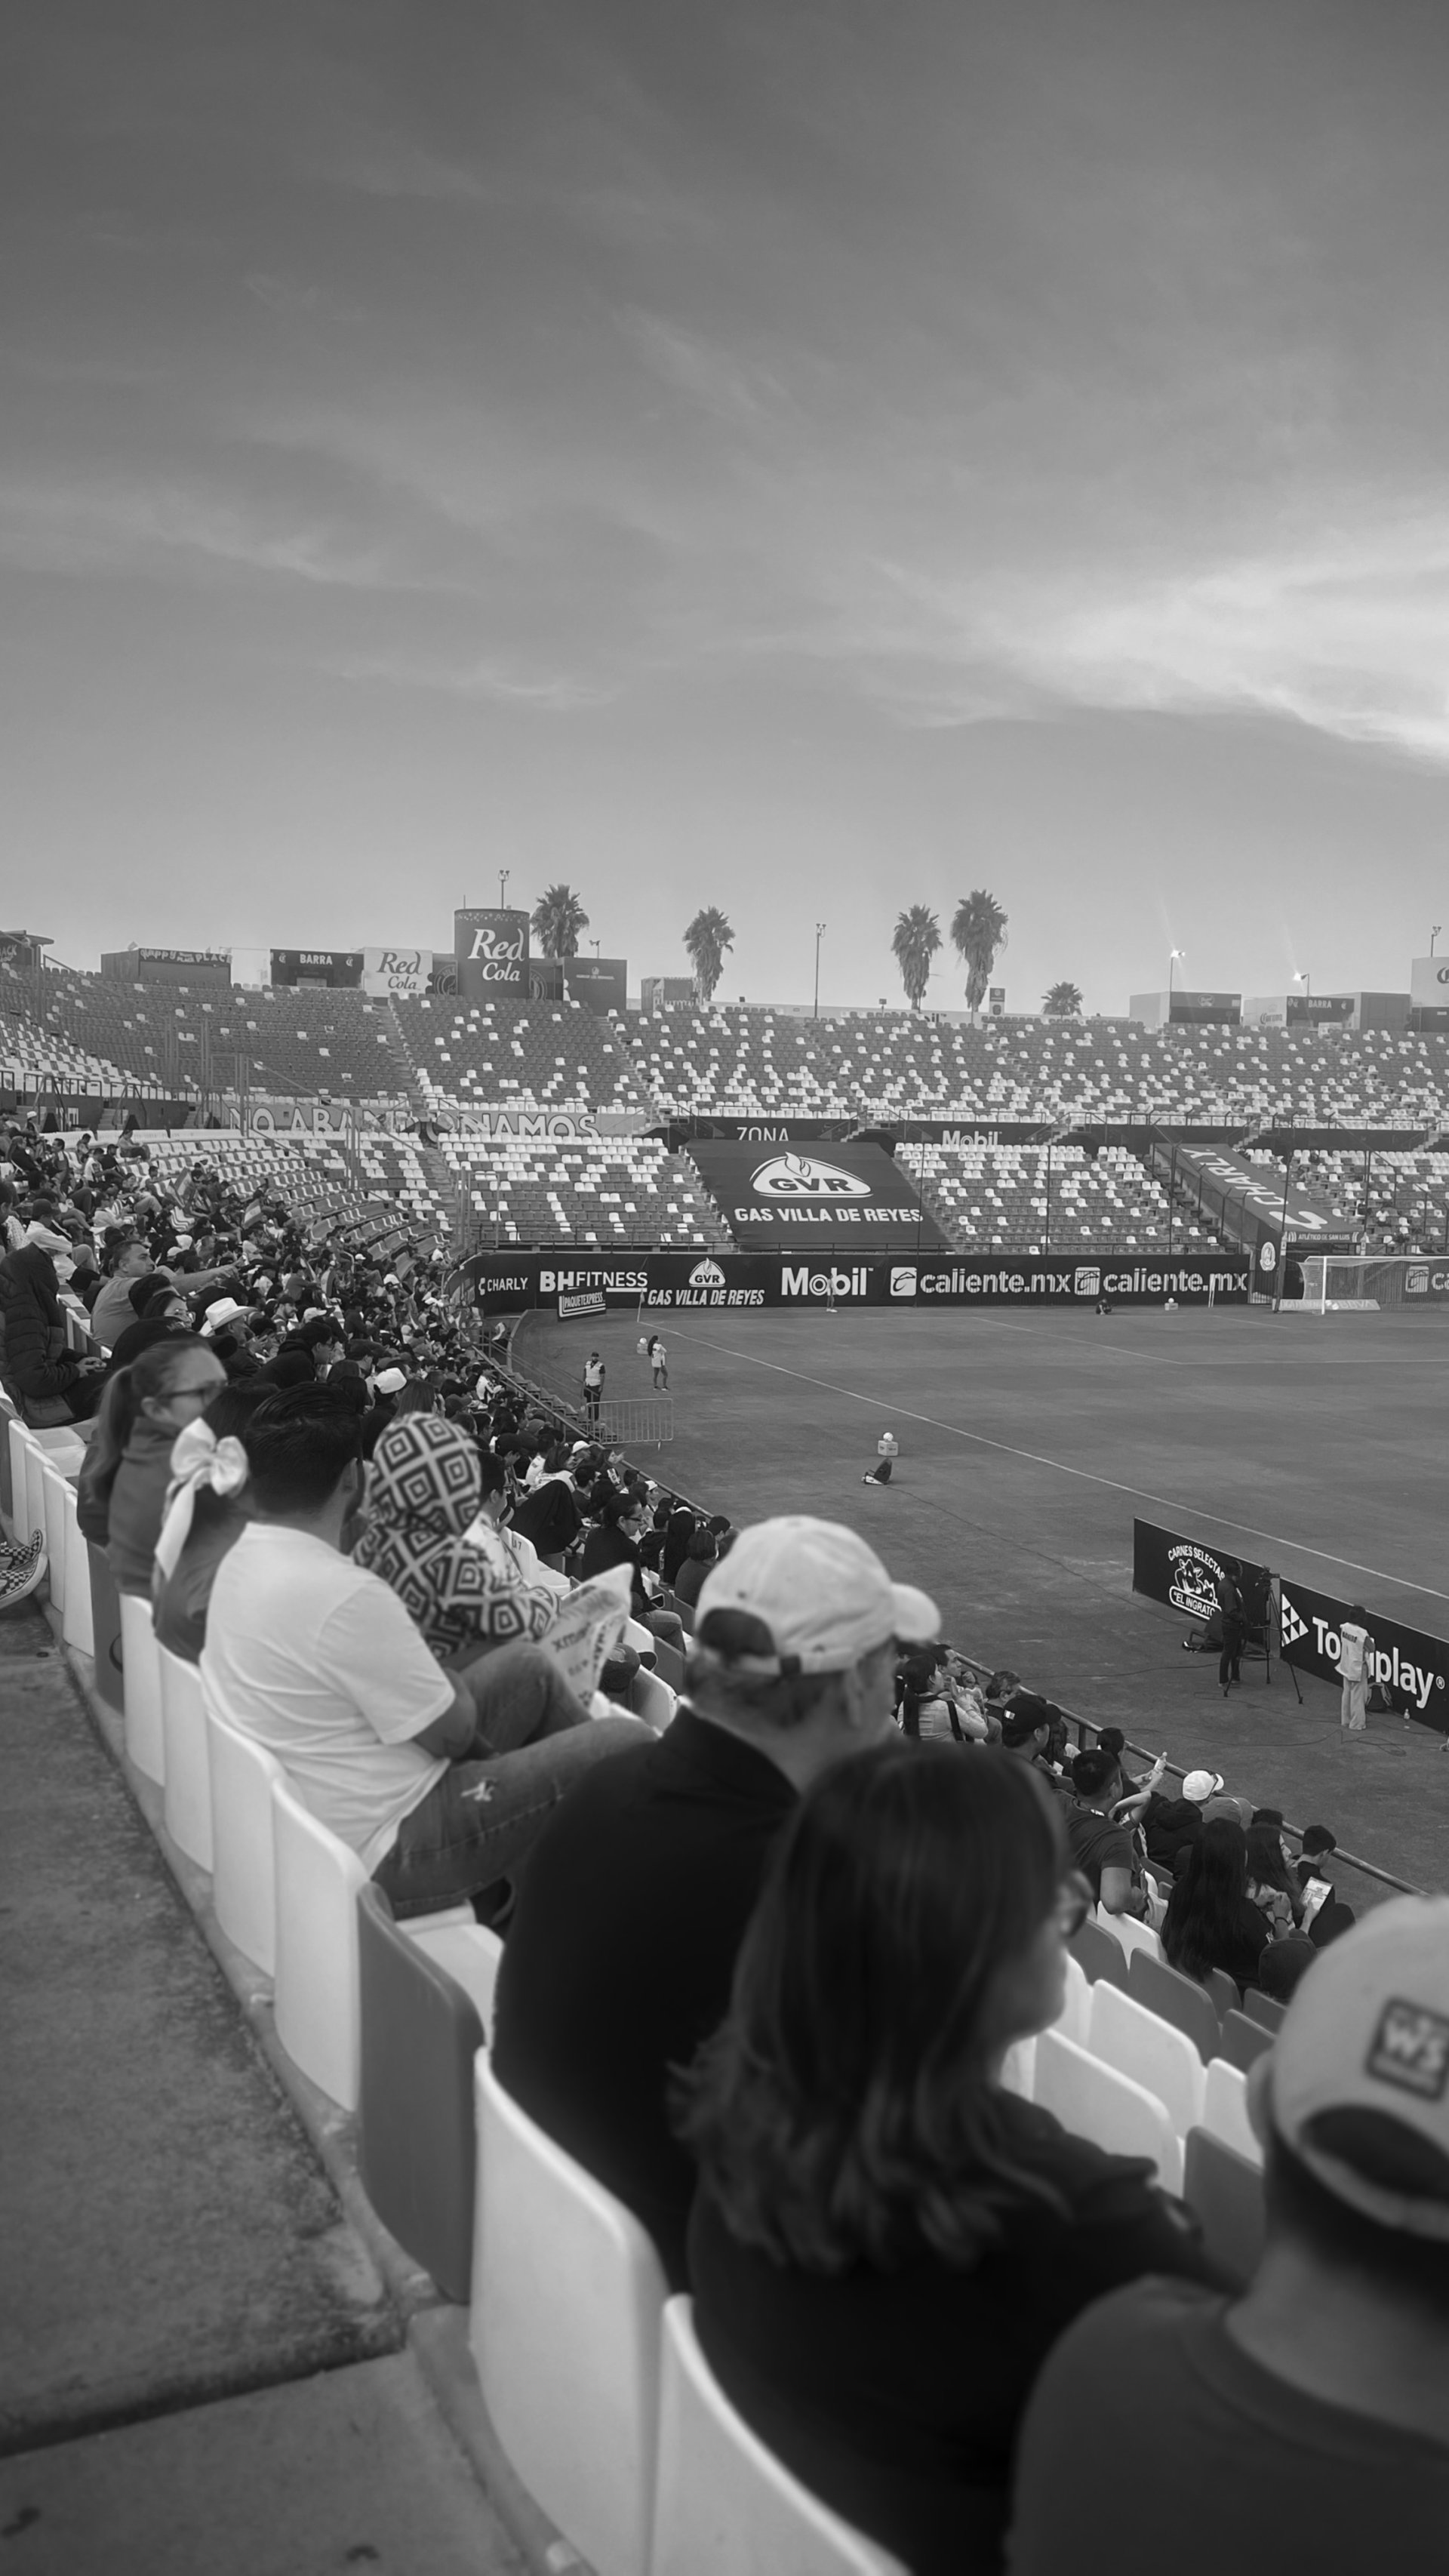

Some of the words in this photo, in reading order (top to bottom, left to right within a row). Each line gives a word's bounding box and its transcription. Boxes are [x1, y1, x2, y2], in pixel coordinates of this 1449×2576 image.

[467, 928, 525, 962] Red
[300, 954, 333, 966] BARRA
[377, 951, 423, 975] Red
[482, 962, 521, 981] Cola
[387, 976, 418, 989] Cola
[1308, 999, 1332, 1009] BARRA
[942, 1131, 998, 1146] Mobil
[768, 1177, 854, 1192] GVR
[734, 1208, 774, 1222] GAS
[777, 1208, 832, 1222] VILLA
[836, 1209, 863, 1222] DE
[866, 1209, 924, 1222] REYES
[488, 1277, 528, 1292] CHARLY
[695, 1275, 720, 1283] GVR
[782, 1268, 866, 1295] Mobil
[921, 1269, 1071, 1293] caliente.mx
[1103, 1268, 1247, 1292] caliente.mx
[648, 1290, 672, 1306] GAS
[674, 1290, 706, 1306] VILLA
[710, 1290, 727, 1306] DE
[728, 1290, 764, 1306] REYES
[1168, 1545, 1193, 1561] CARNES
